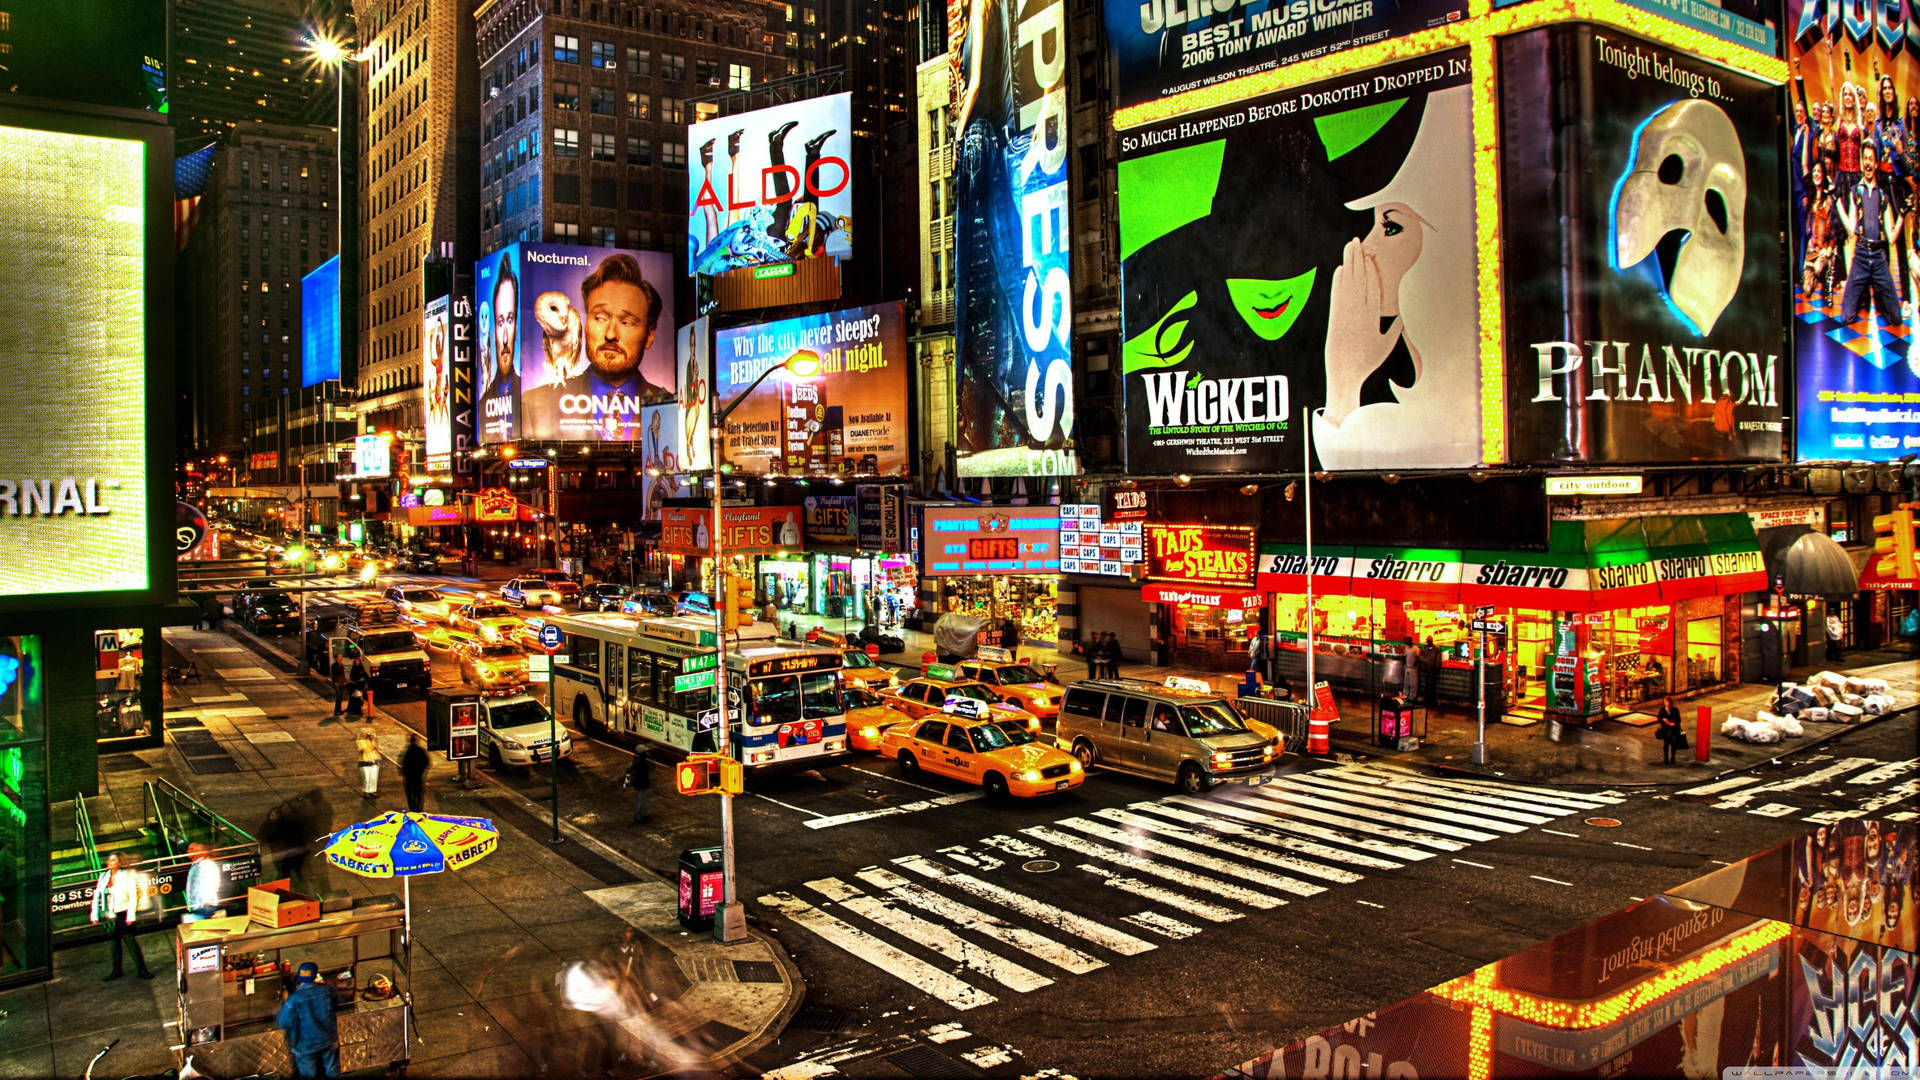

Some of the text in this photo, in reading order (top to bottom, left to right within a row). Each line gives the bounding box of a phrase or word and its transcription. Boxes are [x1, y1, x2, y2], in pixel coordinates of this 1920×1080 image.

[1182, 18, 1244, 51] BEST
[1252, 0, 1358, 32] MUSIC
[1182, 1, 1374, 69] 2006 TONY AWARD WINNER
[1168, 80, 1201, 95] AUGUST
[1203, 71, 1236, 86] WILSON
[1238, 60, 1279, 76] THEATRE,
[1281, 54, 1300, 65] 245
[1301, 46, 1328, 60] WEST
[1352, 29, 1391, 46] STREET
[1595, 35, 1651, 80] Tonight
[1653, 52, 1705, 98] belongs
[689, 156, 850, 217] ALDO
[527, 250, 592, 267] Nocturnal.
[733, 314, 880, 357] Why the city never sleeps?
[823, 341, 888, 373] all night.
[1531, 341, 1778, 408] PHANTOM
[559, 394, 641, 415] CONAN
[678, 378, 707, 411] ALDO
[485, 395, 512, 417] CONAN
[742, 421, 769, 433] Detection
[730, 434, 777, 447] and Travel Spray
[1166, 438, 1195, 446] GERSHWIN
[1235, 436, 1250, 444] WEST
[1262, 435, 1285, 443] STREET
[1559, 478, 1632, 492] city outdoor
[722, 512, 761, 523] Playland
[814, 507, 851, 527] GIFTS
[1063, 507, 1075, 515] CAPS
[1760, 511, 1780, 520] SPACE
[1781, 510, 1794, 518] FOR
[663, 526, 692, 546] GIFTS
[1083, 521, 1096, 529] CAPS
[1125, 522, 1138, 531] CAPS
[971, 539, 1018, 559] GIFTS
[1063, 534, 1076, 543] CAPS
[1103, 536, 1116, 544] CAPS
[1121, 536, 1141, 546] T-SHIRTS
[1083, 549, 1096, 558] CAPS
[1125, 550, 1138, 559] CAPS
[1184, 550, 1248, 577] STEAKS
[1269, 551, 1339, 576] sbarro
[1716, 550, 1758, 575] sbarro
[1064, 561, 1076, 570] CAPS
[1104, 564, 1117, 573] CAPS
[1367, 554, 1445, 582] sbarro
[1476, 560, 1569, 589] sbarro
[1599, 561, 1649, 590] sbarro
[1660, 554, 1707, 581] sbarro
[690, 657, 697, 670] W
[698, 655, 709, 668] 47
[675, 671, 713, 687] FATHER DUFFY
[704, 714, 716, 725] ONE
[447, 836, 495, 865] SABRETT
[330, 853, 389, 873] SABRETT
[51, 892, 66, 904] 49
[68, 890, 83, 902] St
[52, 899, 92, 912] Downtow
